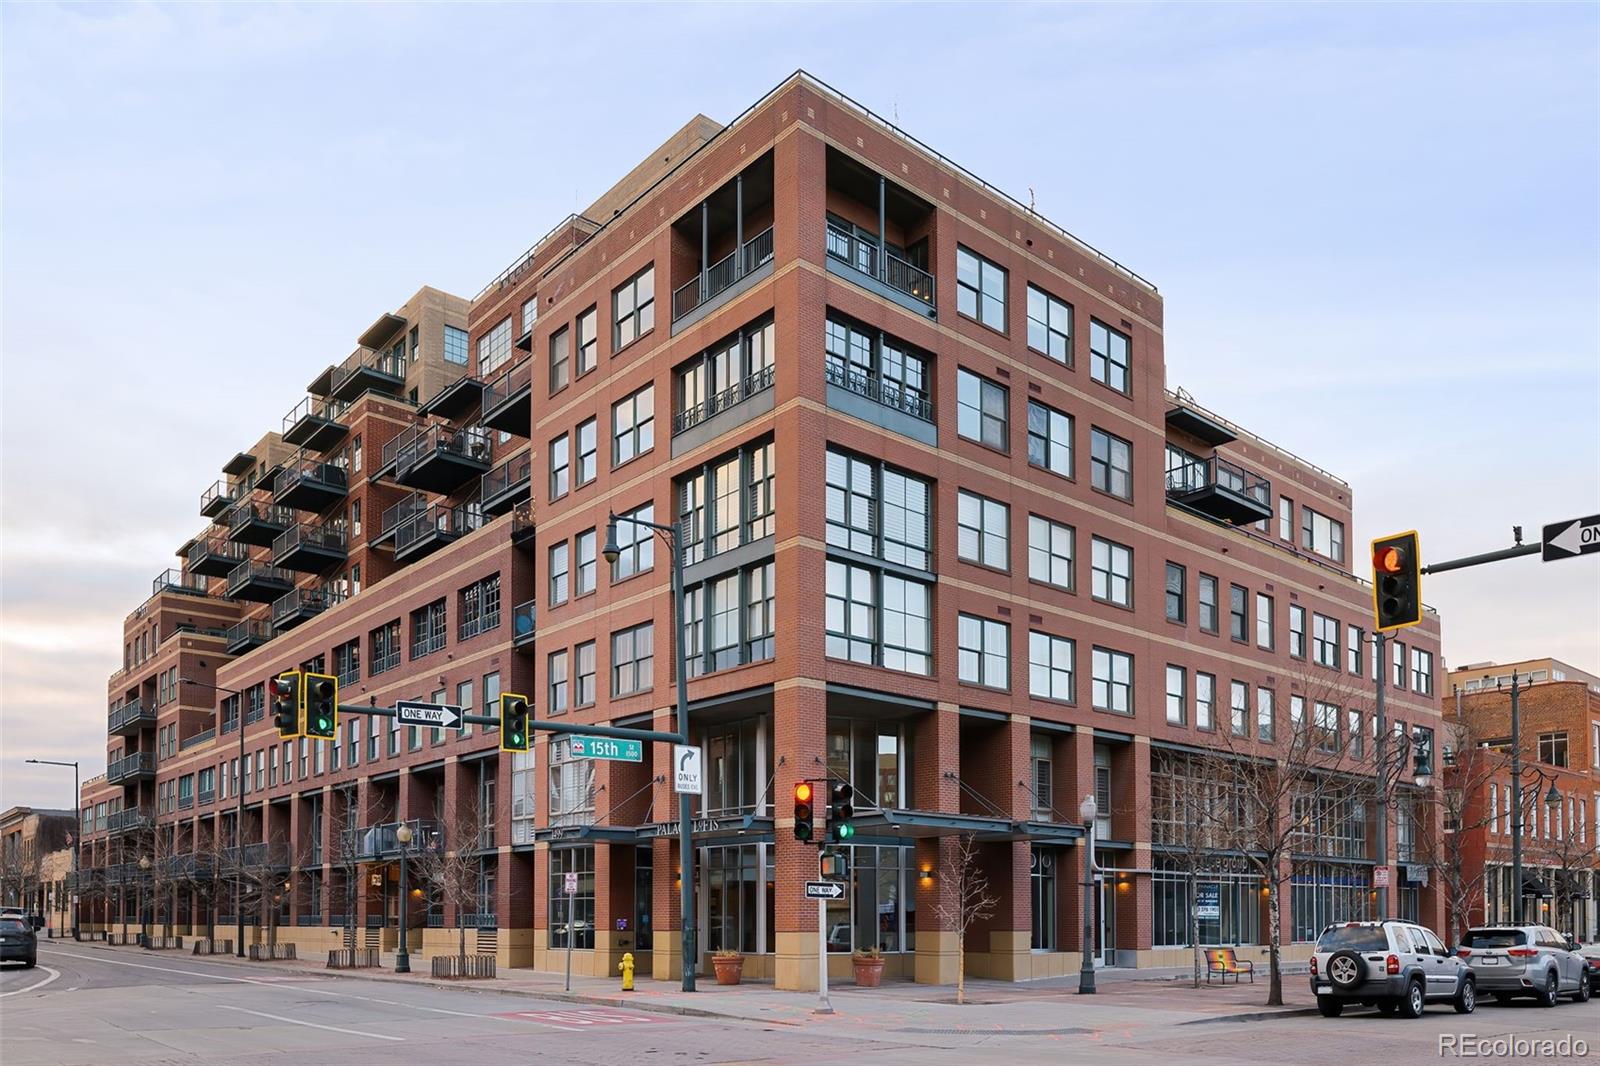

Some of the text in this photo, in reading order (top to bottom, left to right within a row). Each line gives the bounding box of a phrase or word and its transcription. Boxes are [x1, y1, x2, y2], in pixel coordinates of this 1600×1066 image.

[404, 708, 442, 720] ONE WAY
[590, 741, 619, 757] 15th
[678, 773, 698, 782] ONLY
[656, 822, 681, 836] PALAC
